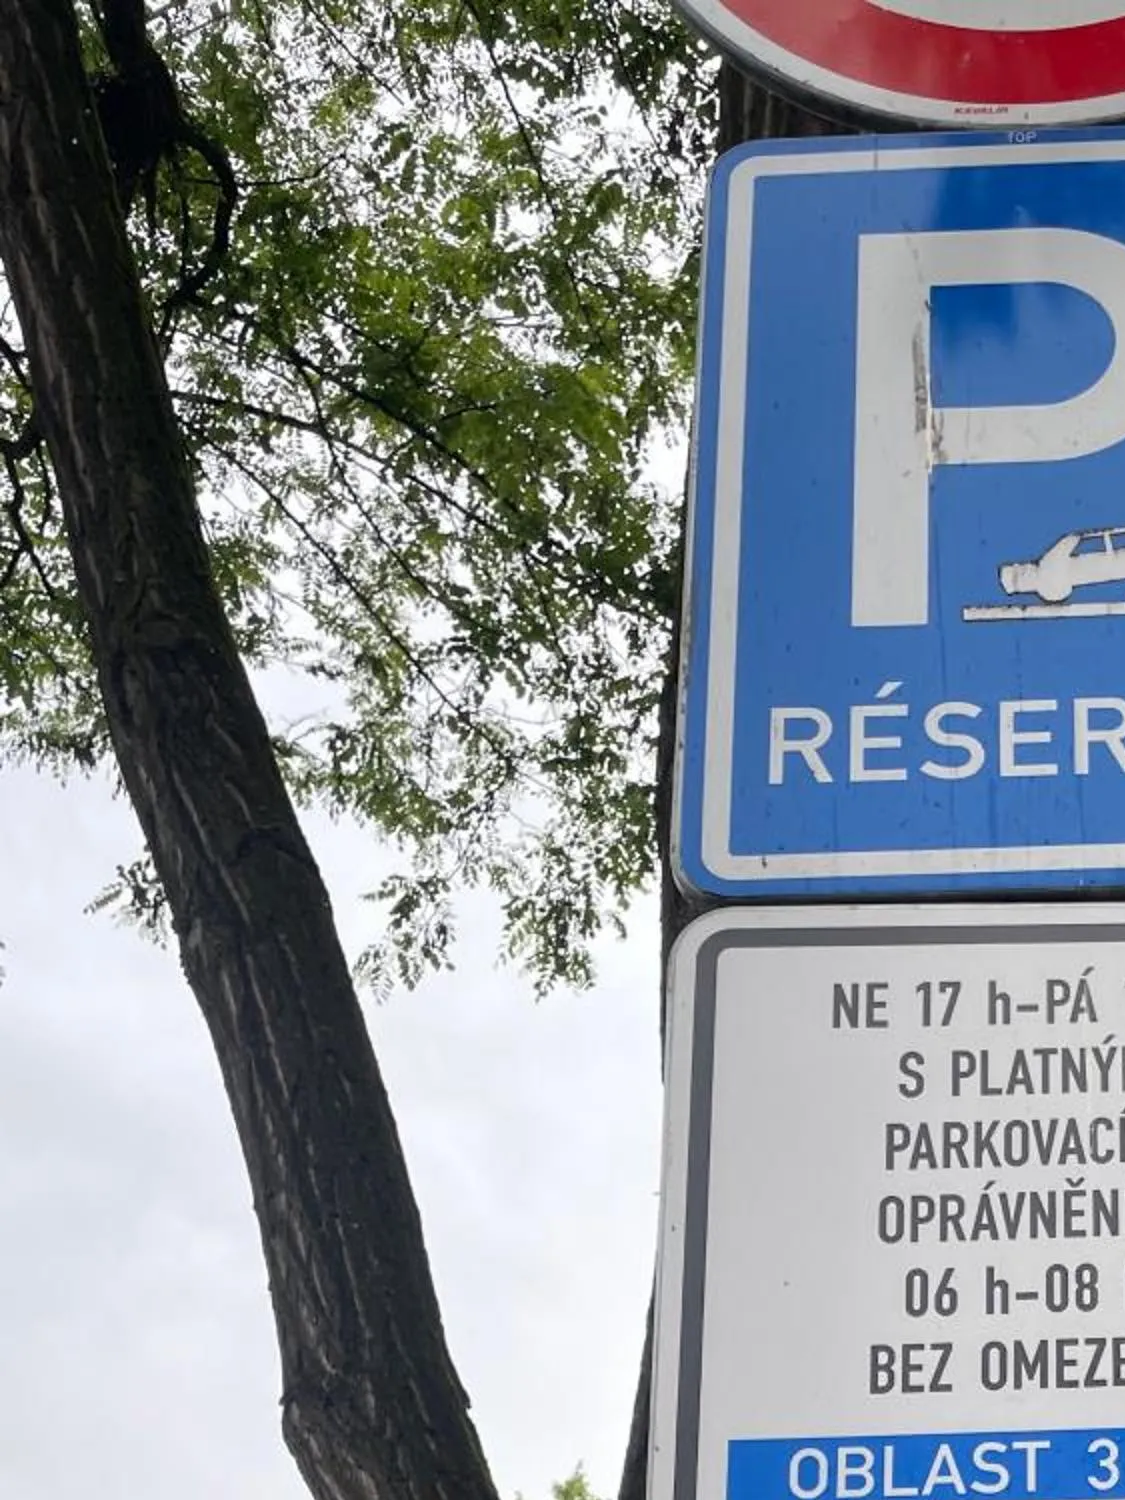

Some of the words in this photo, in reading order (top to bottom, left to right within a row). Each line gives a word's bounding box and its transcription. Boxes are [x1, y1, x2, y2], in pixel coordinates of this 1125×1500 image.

[1008, 131, 1037, 144] TOP
[833, 983, 888, 1028] NE
[917, 982, 960, 1026] 17
[899, 1052, 924, 1098] S
[906, 1268, 957, 1317] 06
[870, 1343, 952, 1394] BEZ
[788, 1440, 1051, 1500] OBLAST
